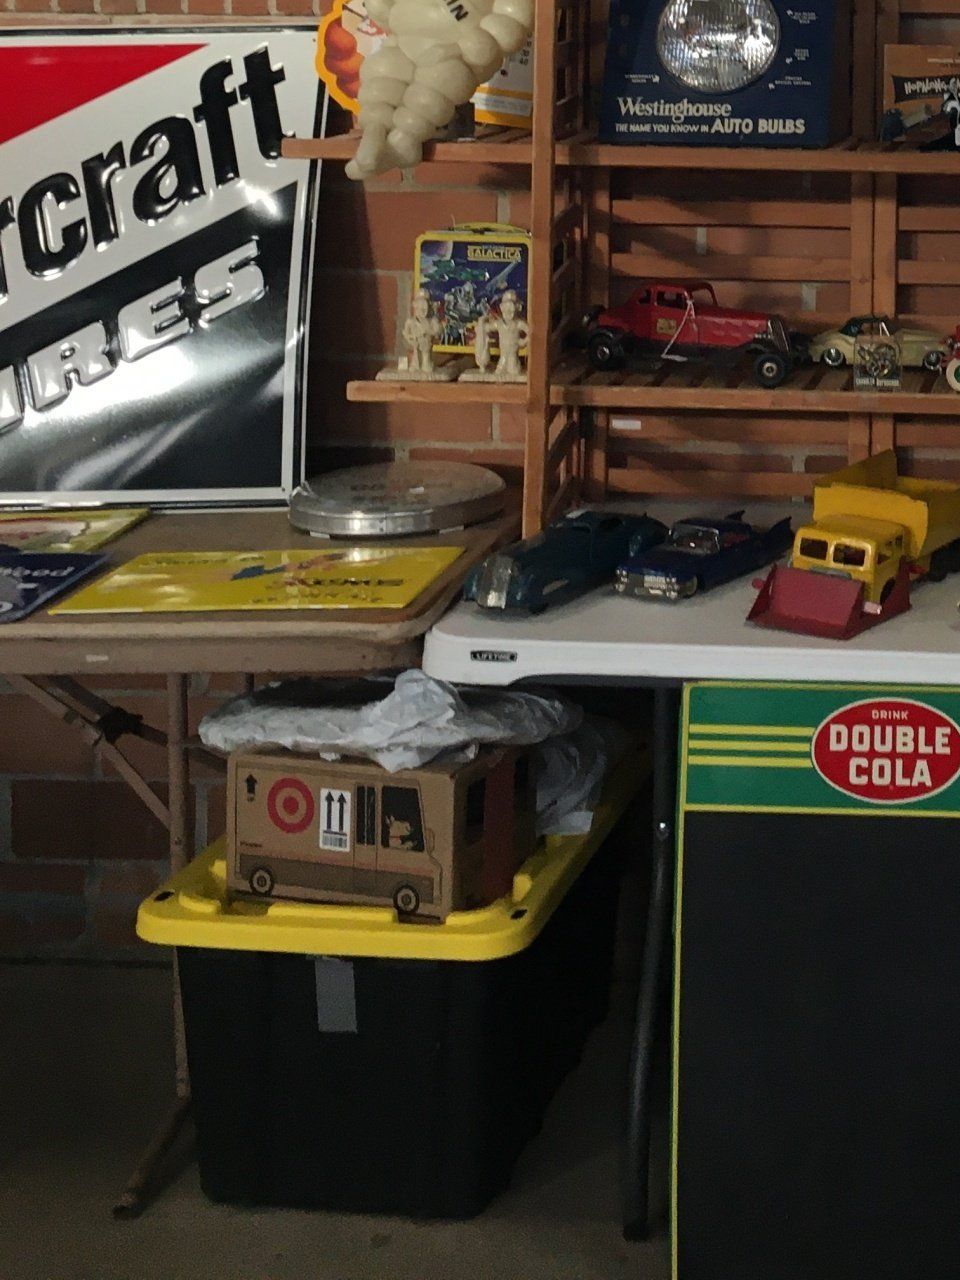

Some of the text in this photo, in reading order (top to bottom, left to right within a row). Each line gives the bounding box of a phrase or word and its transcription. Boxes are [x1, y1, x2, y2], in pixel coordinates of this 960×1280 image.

[617, 97, 732, 124] Westinghouse
[615, 123, 628, 133] THE
[630, 123, 651, 133] NAME
[653, 123, 669, 133] YOU
[671, 124, 699, 133] KNOW
[711, 119, 753, 135] AUTO
[758, 118, 805, 135] BULBS
[871, 709, 909, 721] DRINK
[828, 722, 952, 756] DOUBLE
[848, 757, 933, 788] COLA
